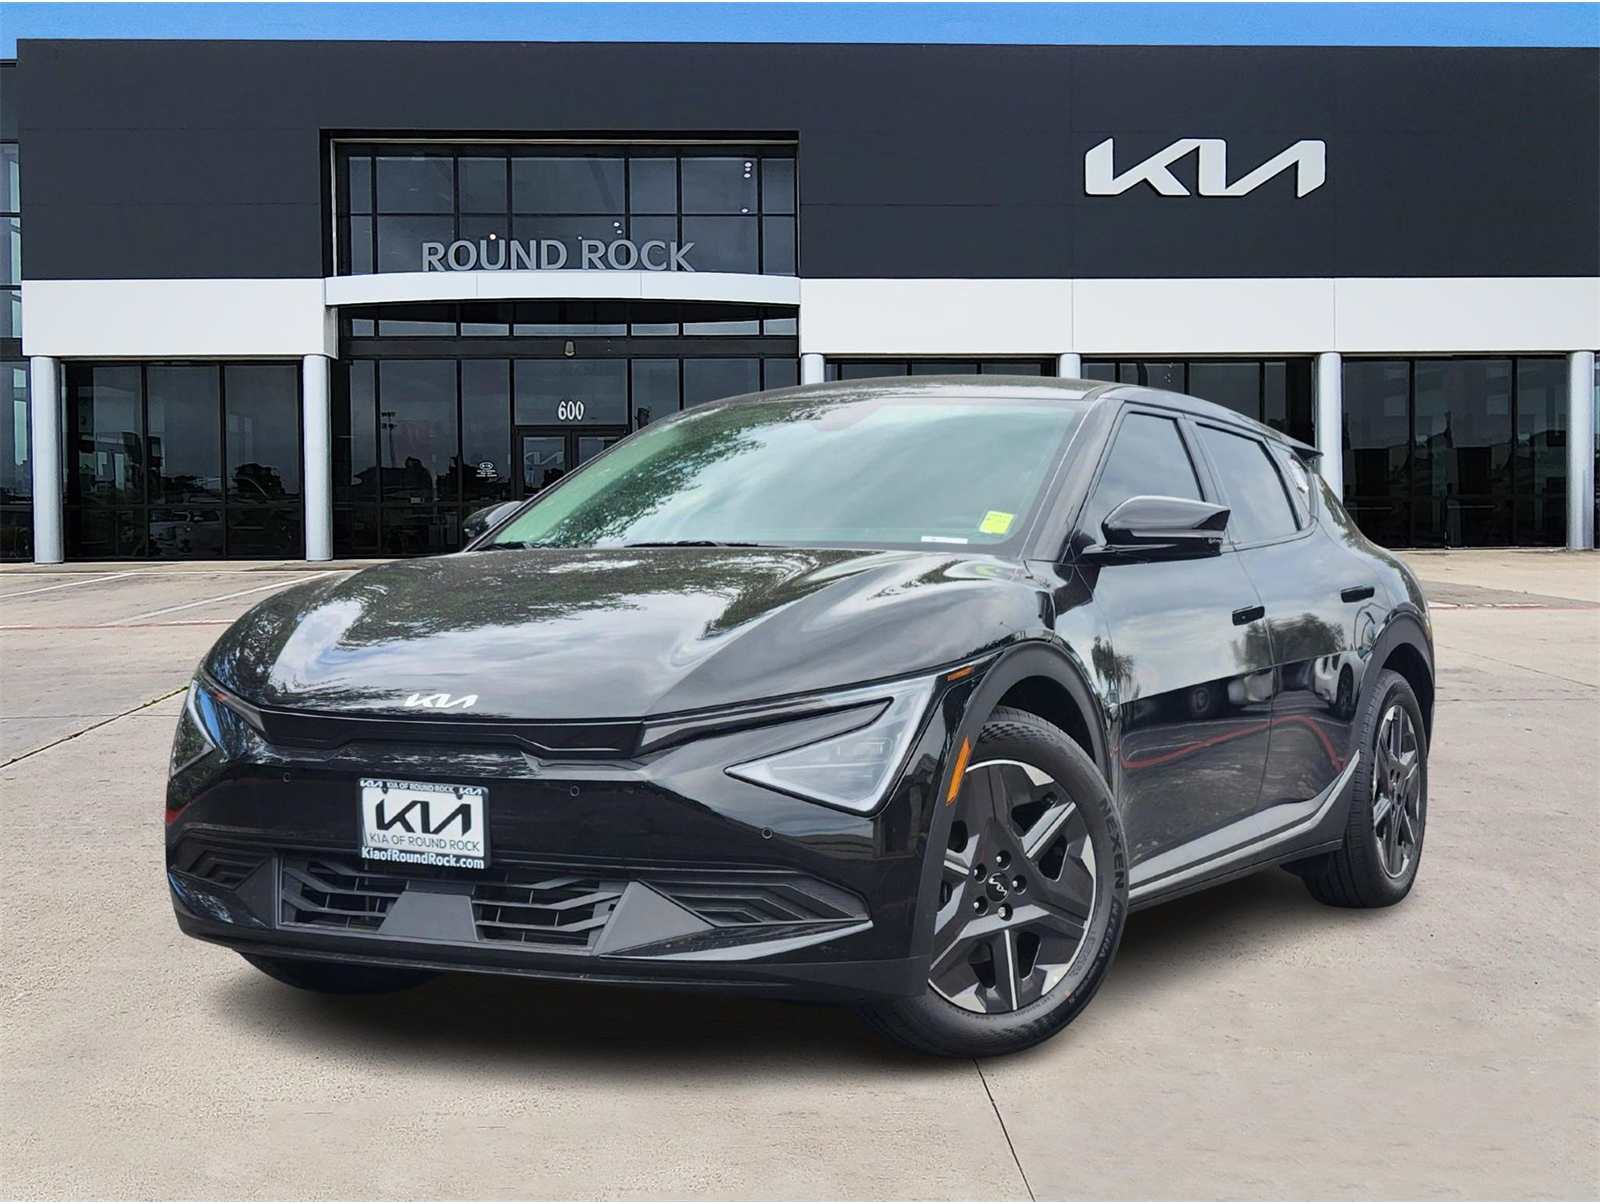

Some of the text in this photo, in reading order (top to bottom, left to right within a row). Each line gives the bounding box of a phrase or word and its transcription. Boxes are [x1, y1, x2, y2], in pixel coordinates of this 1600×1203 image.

[1085, 138, 1326, 198] KIA
[422, 240, 695, 272] ROUND ROCK
[558, 401, 584, 420] 600
[404, 693, 479, 709] KIA
[375, 799, 472, 836] KIA
[369, 832, 481, 852] KIA OF ROUND ROCK
[1101, 798, 1125, 889] NEXEN
[361, 846, 485, 870] KiaofRoundRock.com
